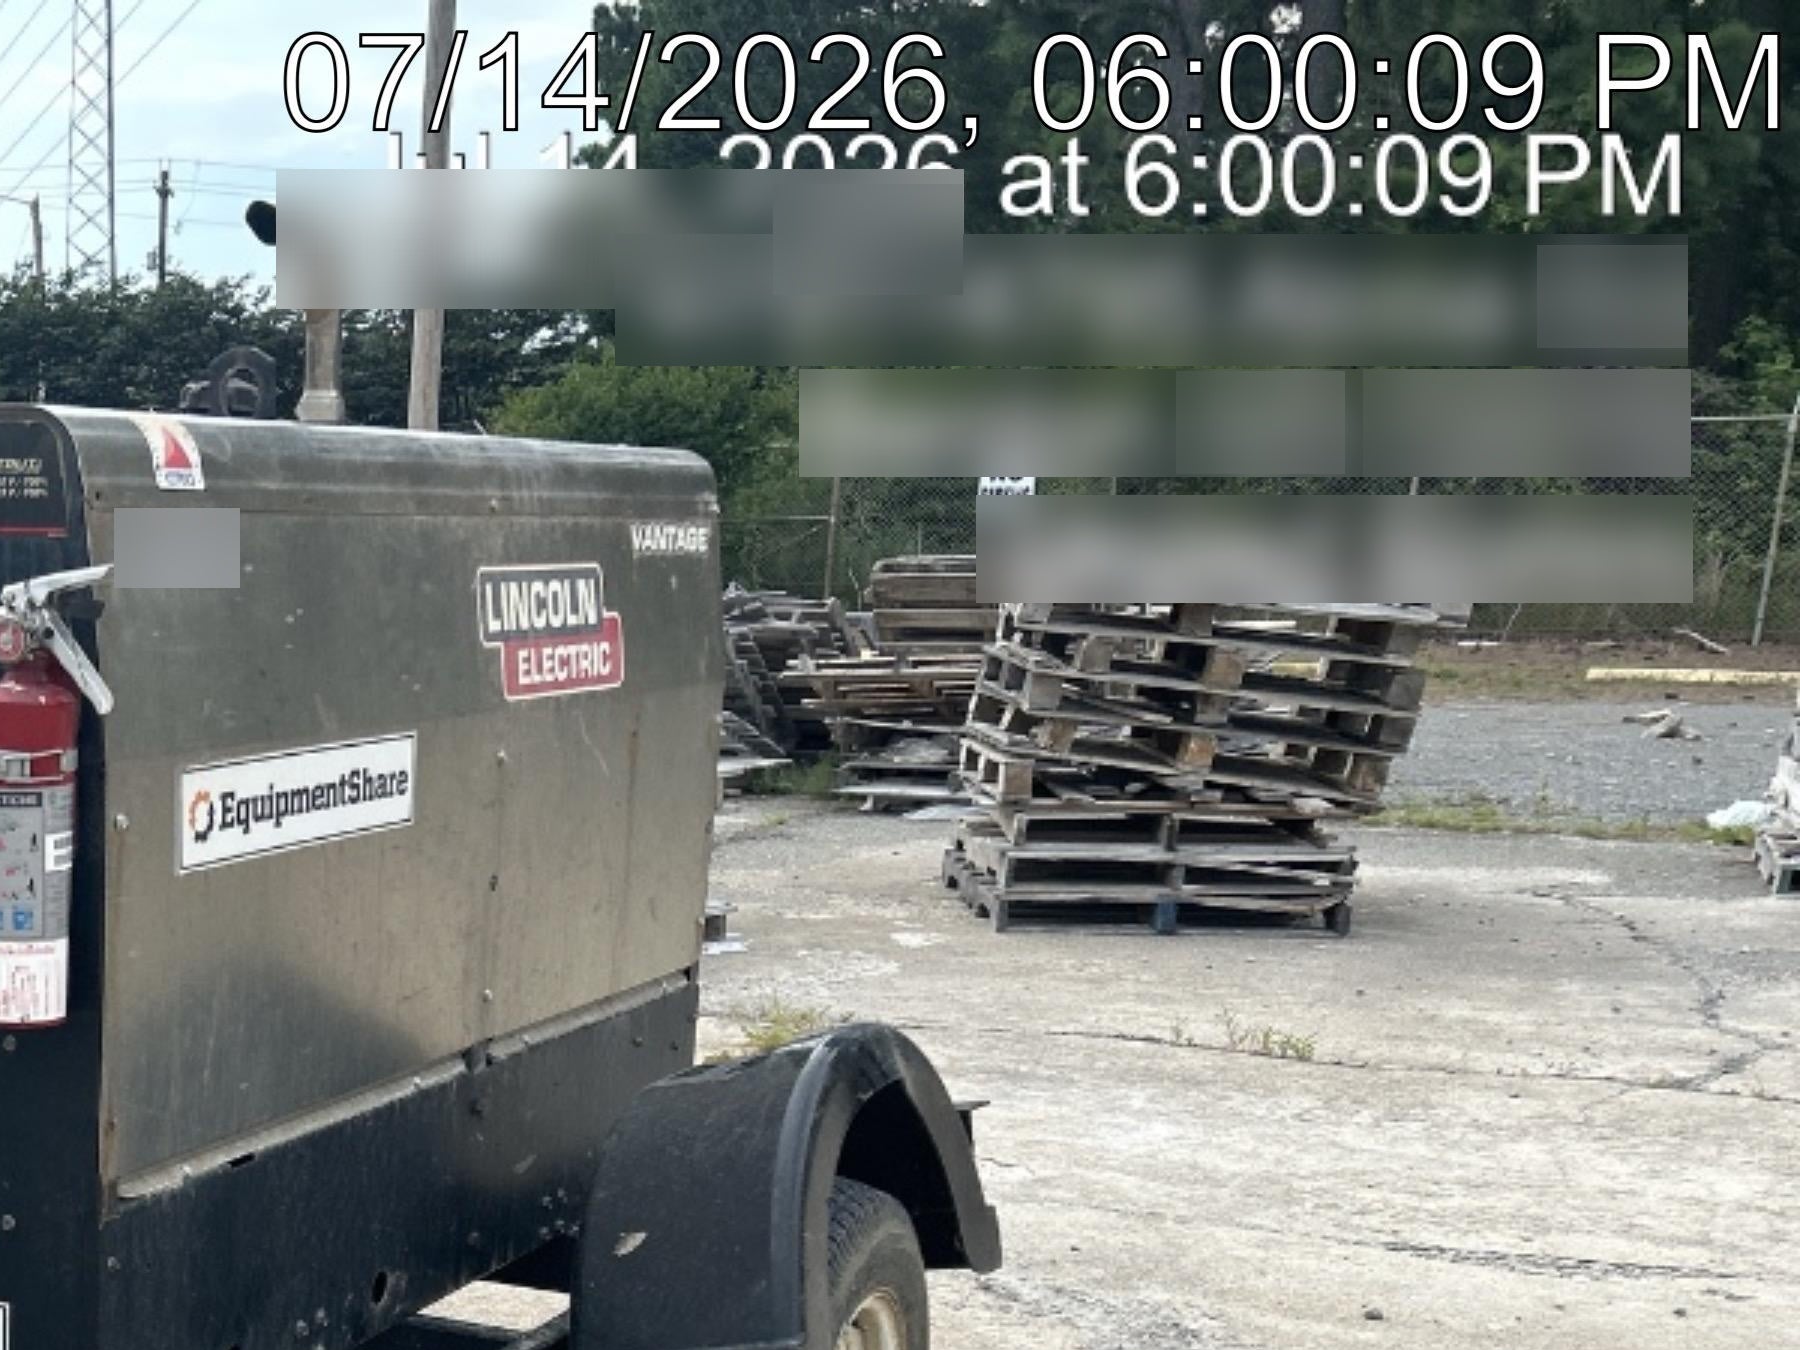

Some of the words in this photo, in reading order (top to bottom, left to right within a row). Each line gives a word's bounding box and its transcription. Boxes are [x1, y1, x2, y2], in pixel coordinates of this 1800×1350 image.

[630, 524, 710, 553] VANTAGE
[485, 577, 599, 634] LINCOLN
[517, 641, 612, 686] ELECTRIC
[218, 767, 409, 835] EquipmentShare
